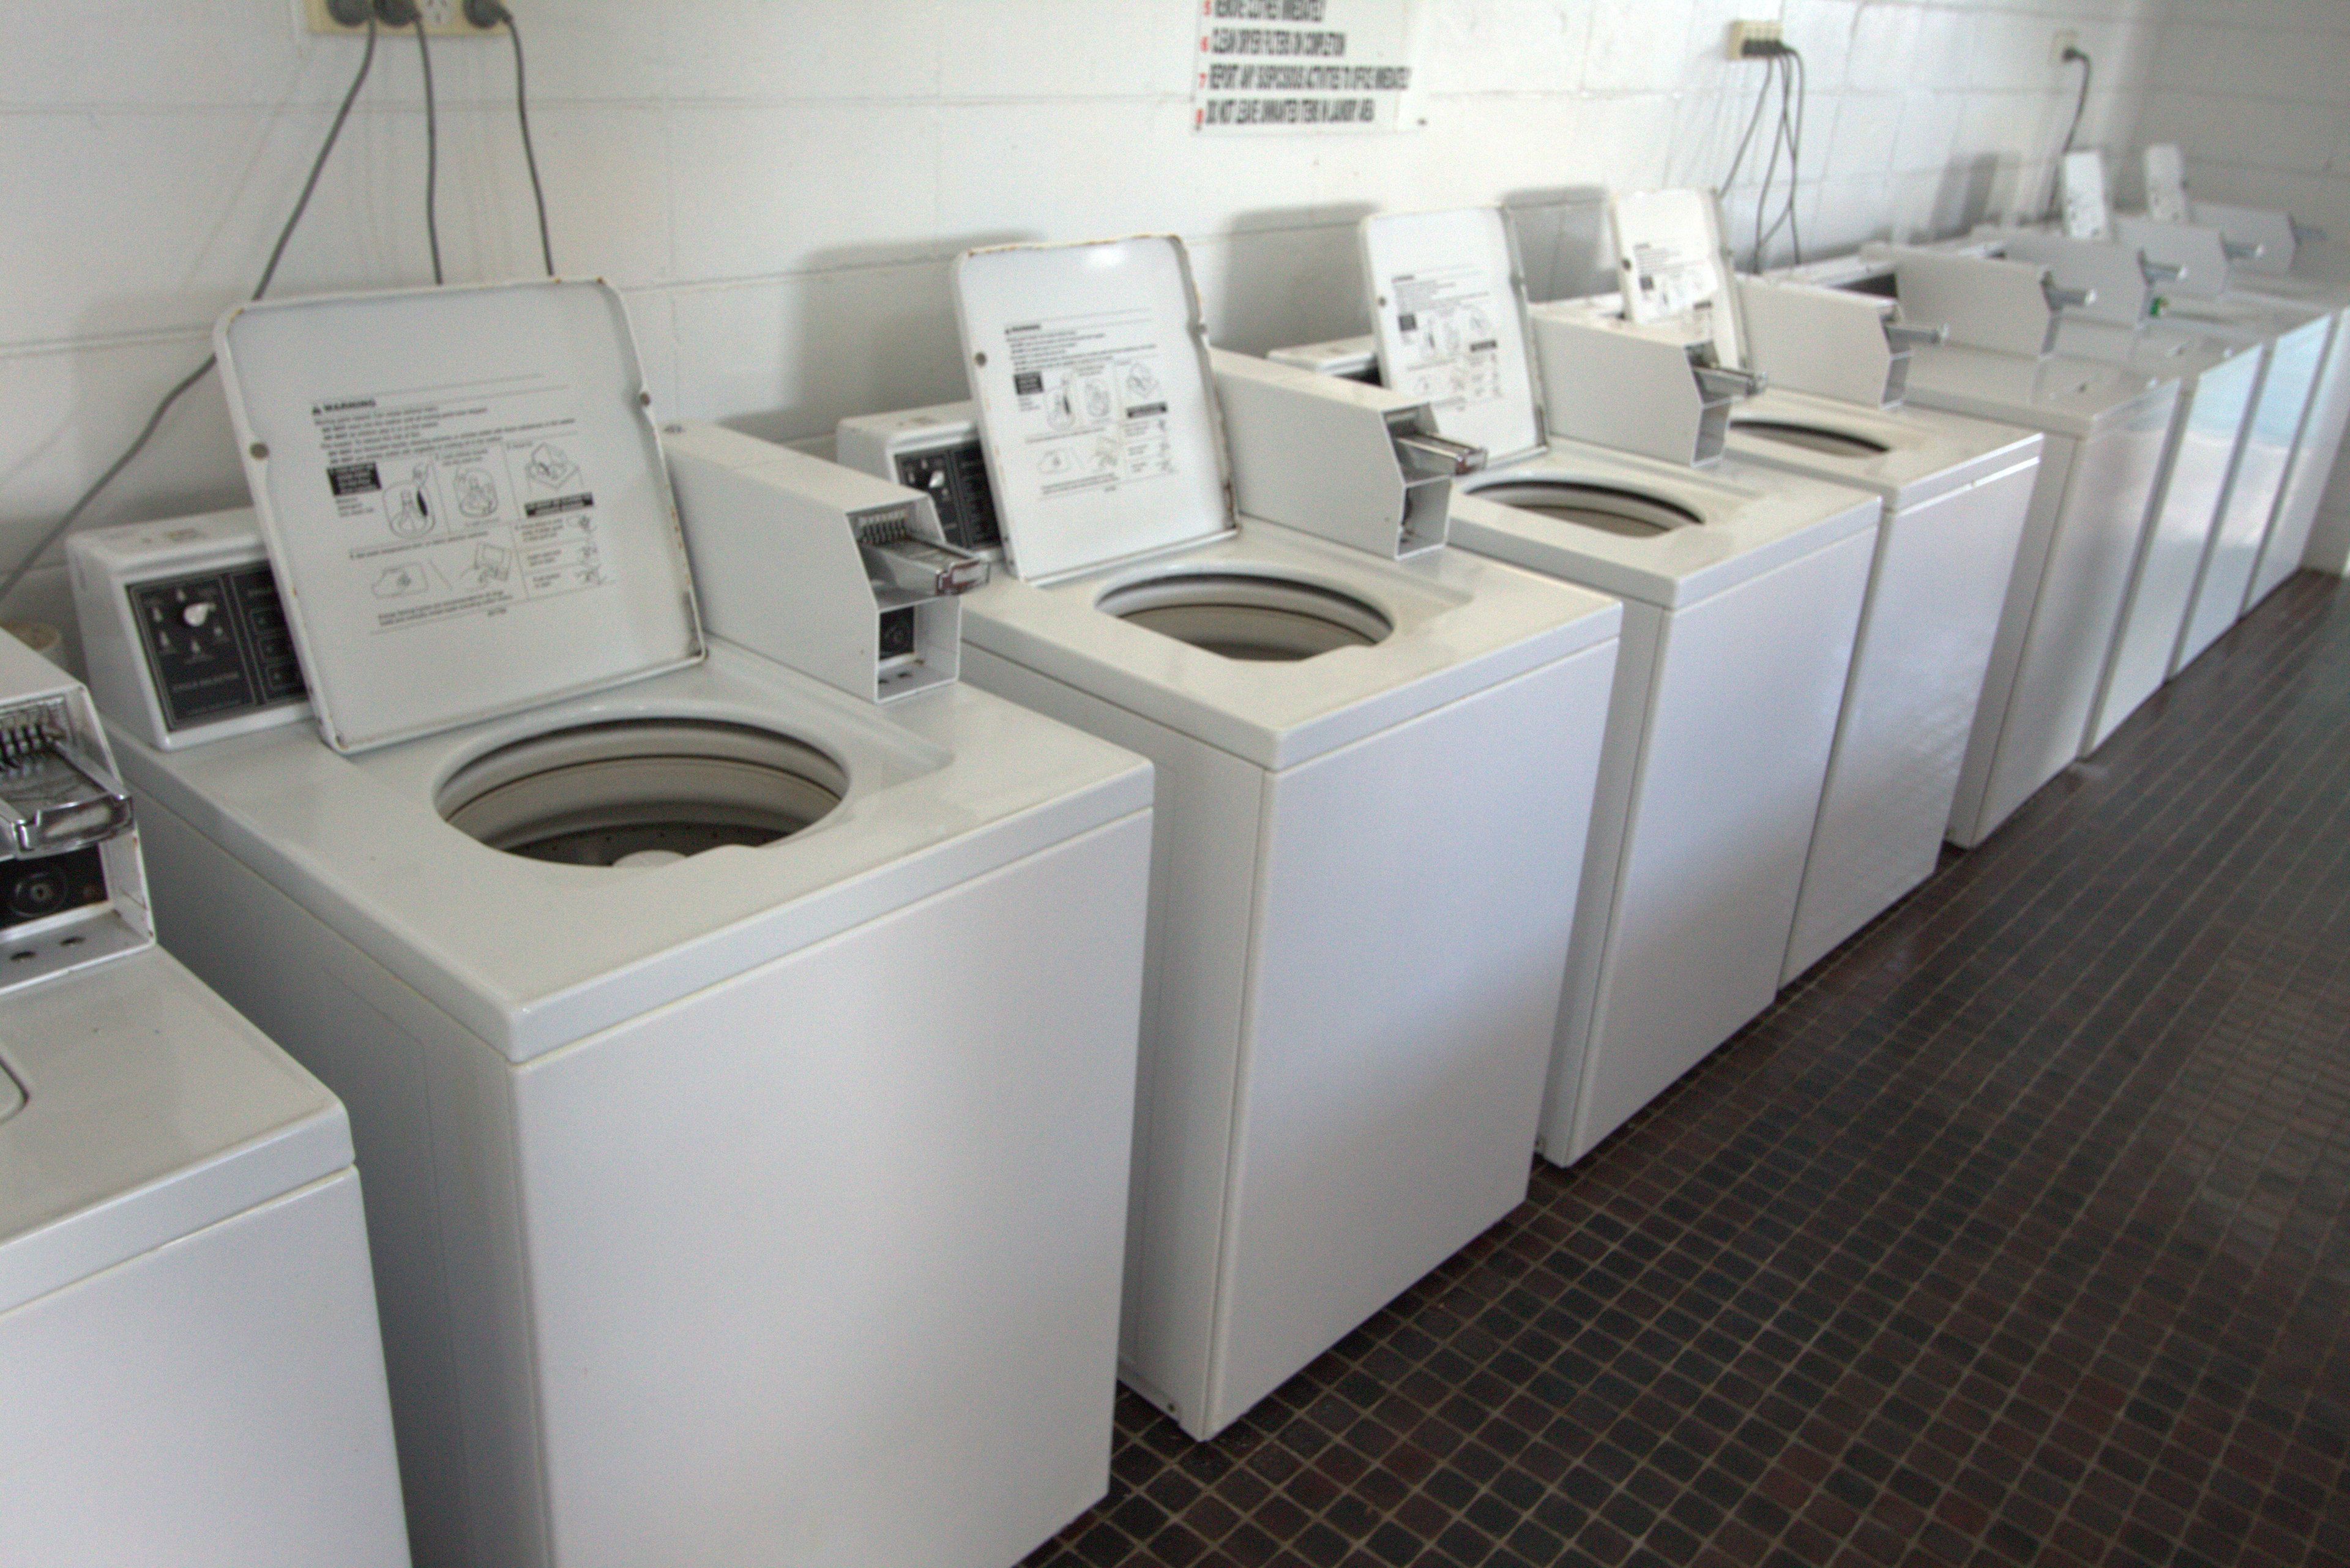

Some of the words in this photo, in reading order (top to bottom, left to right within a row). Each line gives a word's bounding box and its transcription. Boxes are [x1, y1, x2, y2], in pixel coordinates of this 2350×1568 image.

[1200, 36, 1209, 52] 6
[1211, 28, 1236, 54] CLEAN
[1199, 73, 1207, 88] 7
[1209, 64, 1239, 90] REPORT
[1240, 64, 1255, 90] ANY
[1206, 99, 1218, 124] DO
[1218, 99, 1234, 124] NOT
[1236, 99, 1259, 124] LEAVE
